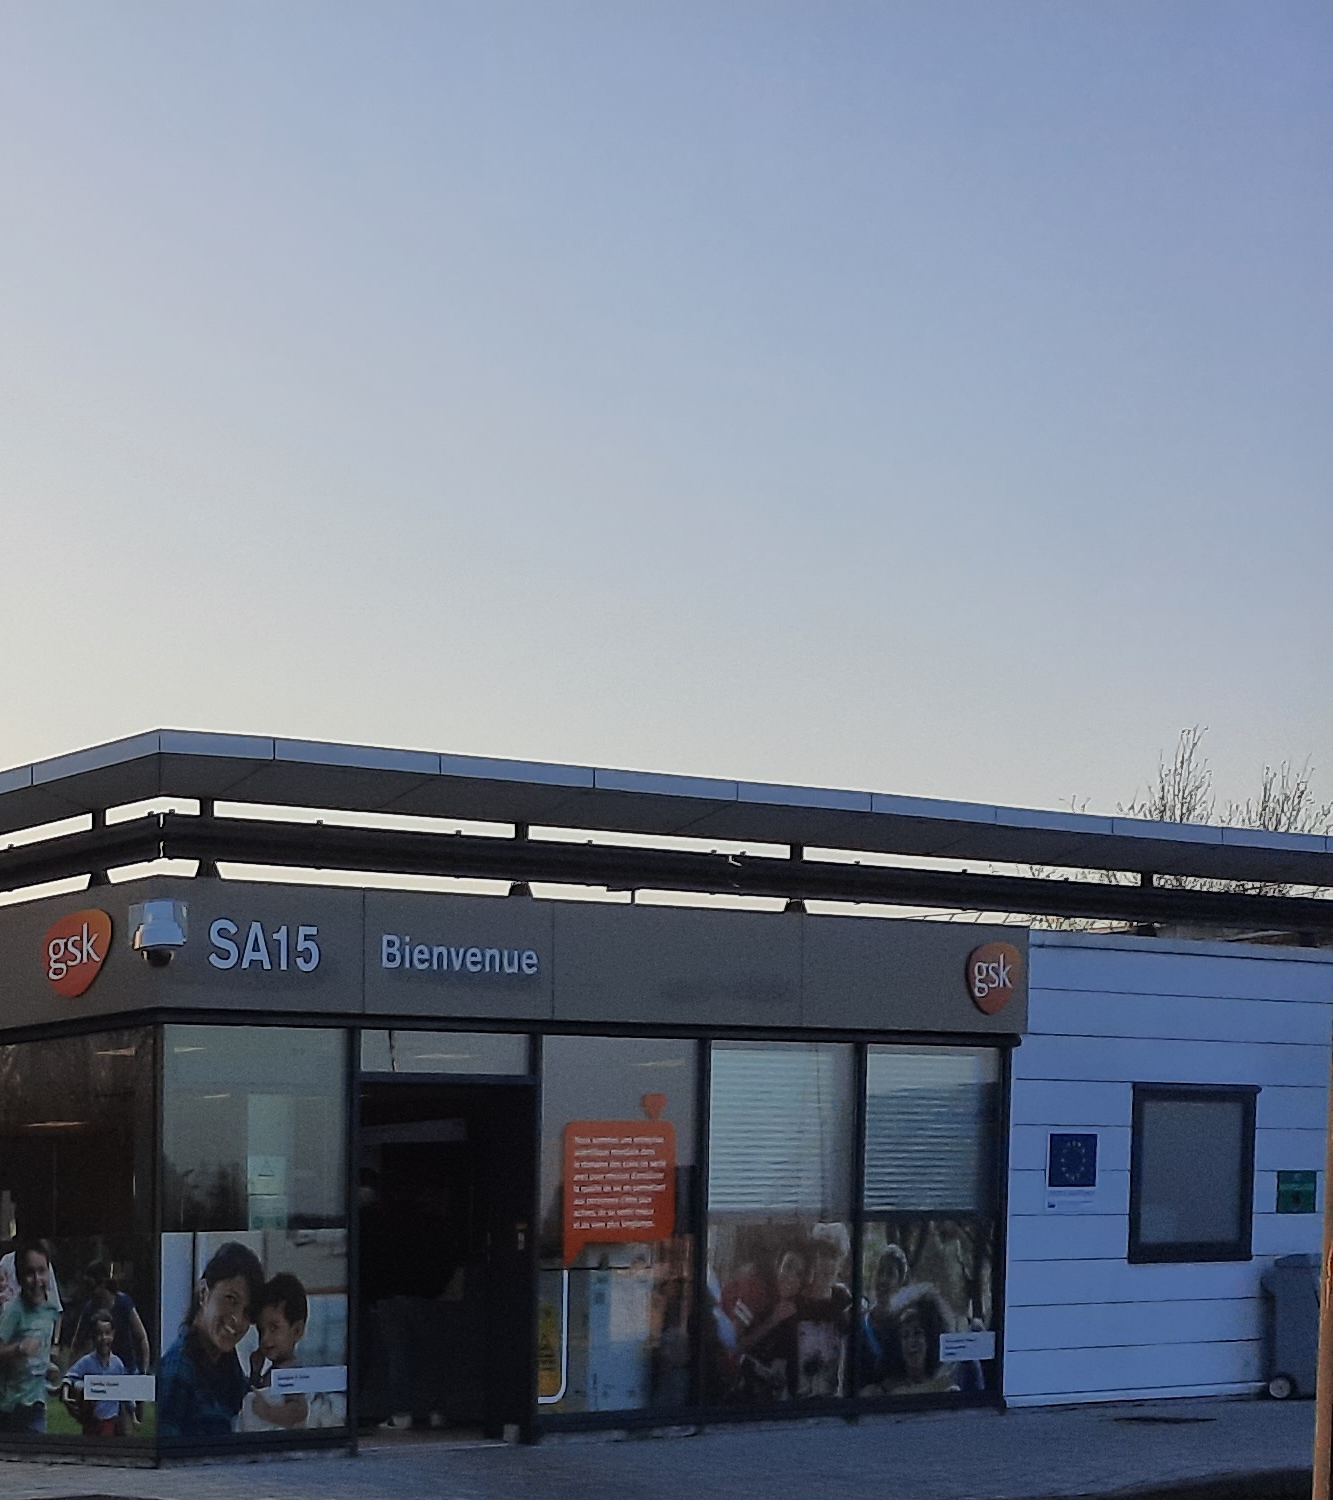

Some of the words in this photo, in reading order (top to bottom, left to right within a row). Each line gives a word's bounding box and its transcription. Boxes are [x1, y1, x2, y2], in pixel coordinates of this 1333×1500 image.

[47, 922, 102, 980] gsk
[208, 918, 322, 973] SA15
[381, 934, 539, 975] Bienvenue
[974, 953, 1013, 997] gsk
